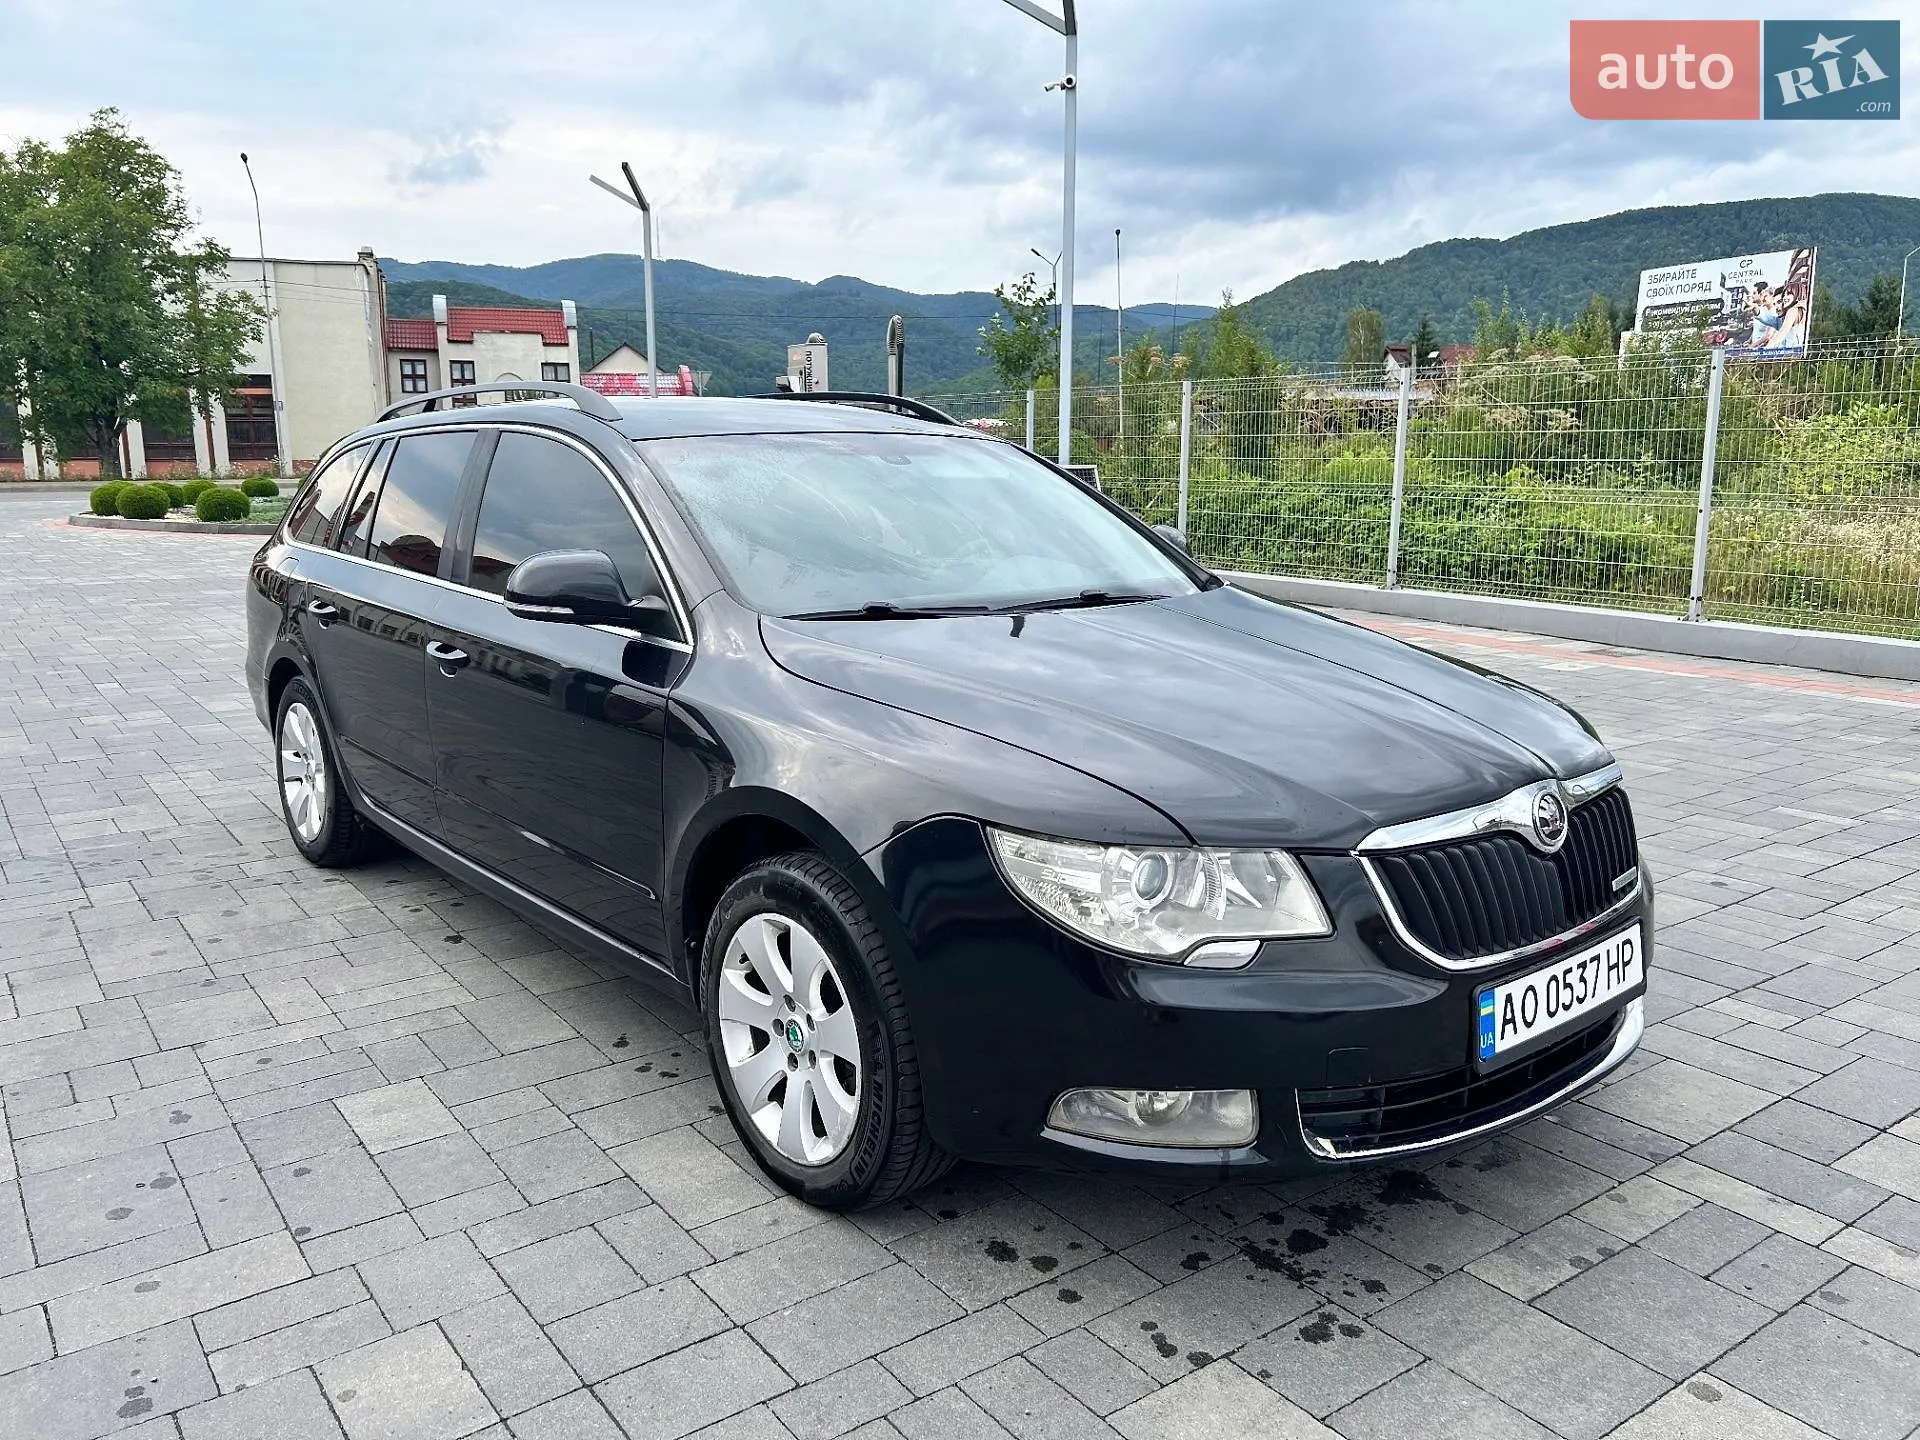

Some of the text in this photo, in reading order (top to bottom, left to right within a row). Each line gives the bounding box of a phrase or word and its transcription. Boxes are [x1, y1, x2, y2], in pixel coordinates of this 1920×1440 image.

[1647, 268, 1697, 285] ЗБИРАЙТЕ
[1728, 269, 1764, 280] CENTRAL
[1646, 281, 1712, 299] СВОЇХ ПОРЯД
[1546, 953, 1600, 1019] 0537
[1480, 1033, 1494, 1048] UA
[854, 1079, 885, 1181] MICHELIN
